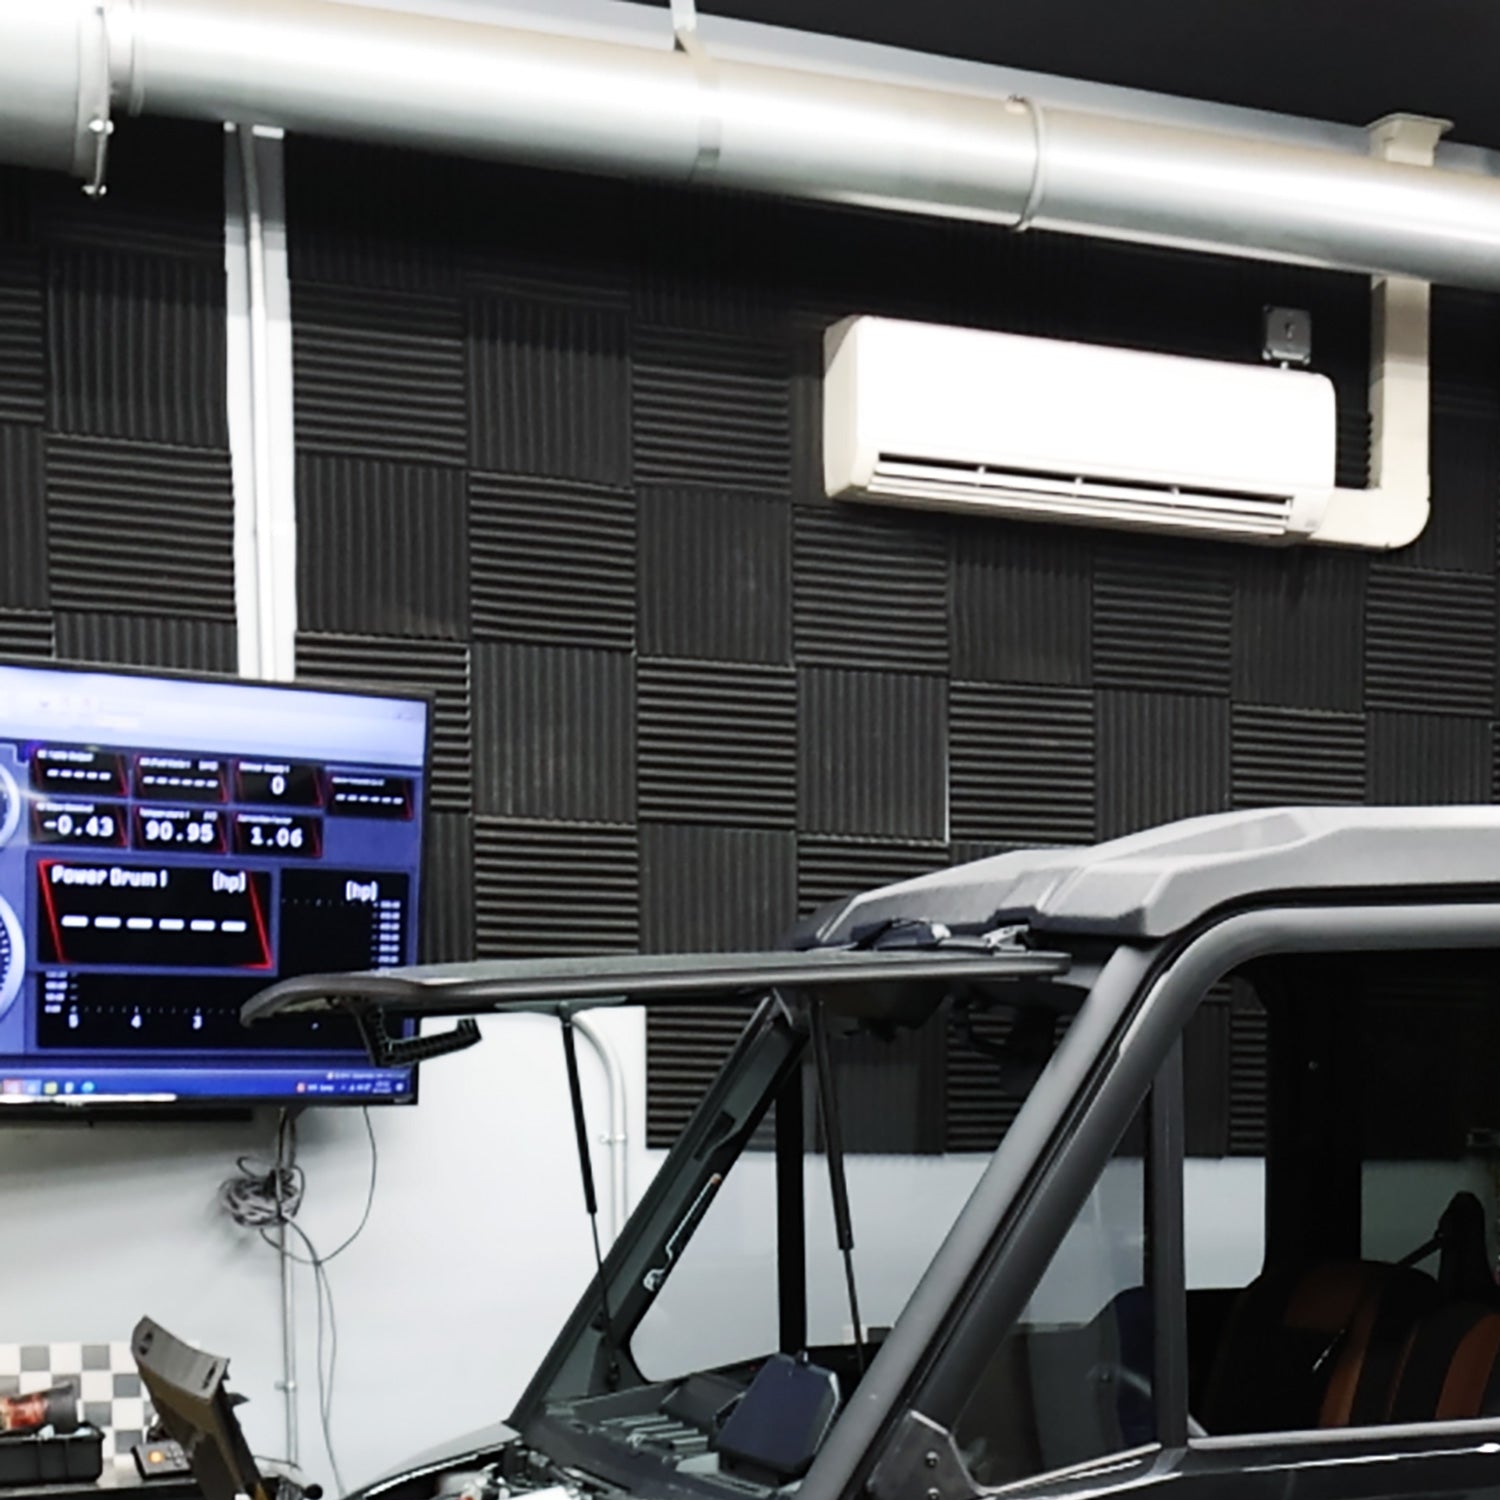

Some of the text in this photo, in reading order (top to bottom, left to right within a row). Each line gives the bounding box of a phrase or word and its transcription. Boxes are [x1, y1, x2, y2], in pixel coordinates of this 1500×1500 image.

[250, 826, 303, 848] 1.06
[51, 864, 108, 886] Power
[109, 867, 158, 888] Drum
